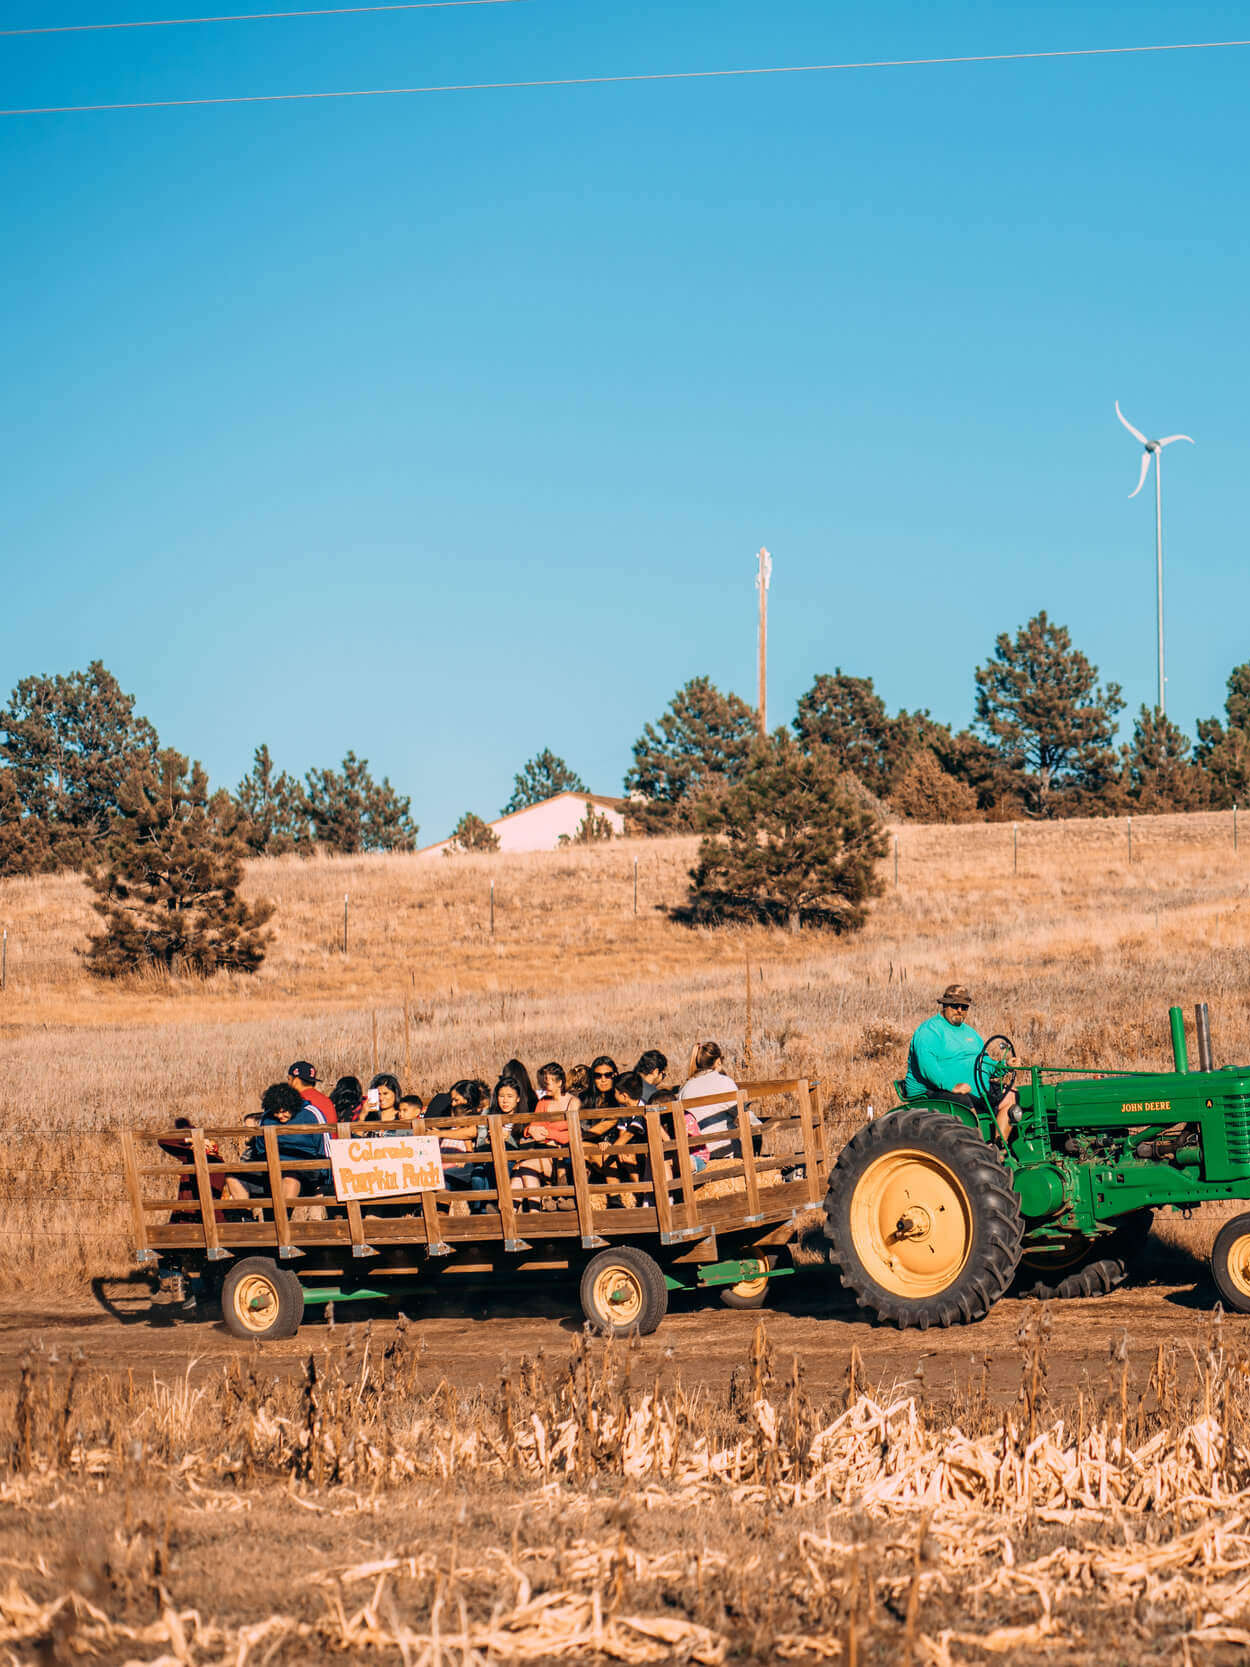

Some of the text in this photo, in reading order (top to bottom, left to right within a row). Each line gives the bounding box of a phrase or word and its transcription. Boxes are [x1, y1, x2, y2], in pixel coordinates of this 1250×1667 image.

[1121, 1101, 1171, 1113] JOHN DEERE
[348, 1141, 414, 1162] Colorado
[339, 1161, 440, 1194] Pumpkin Patch
